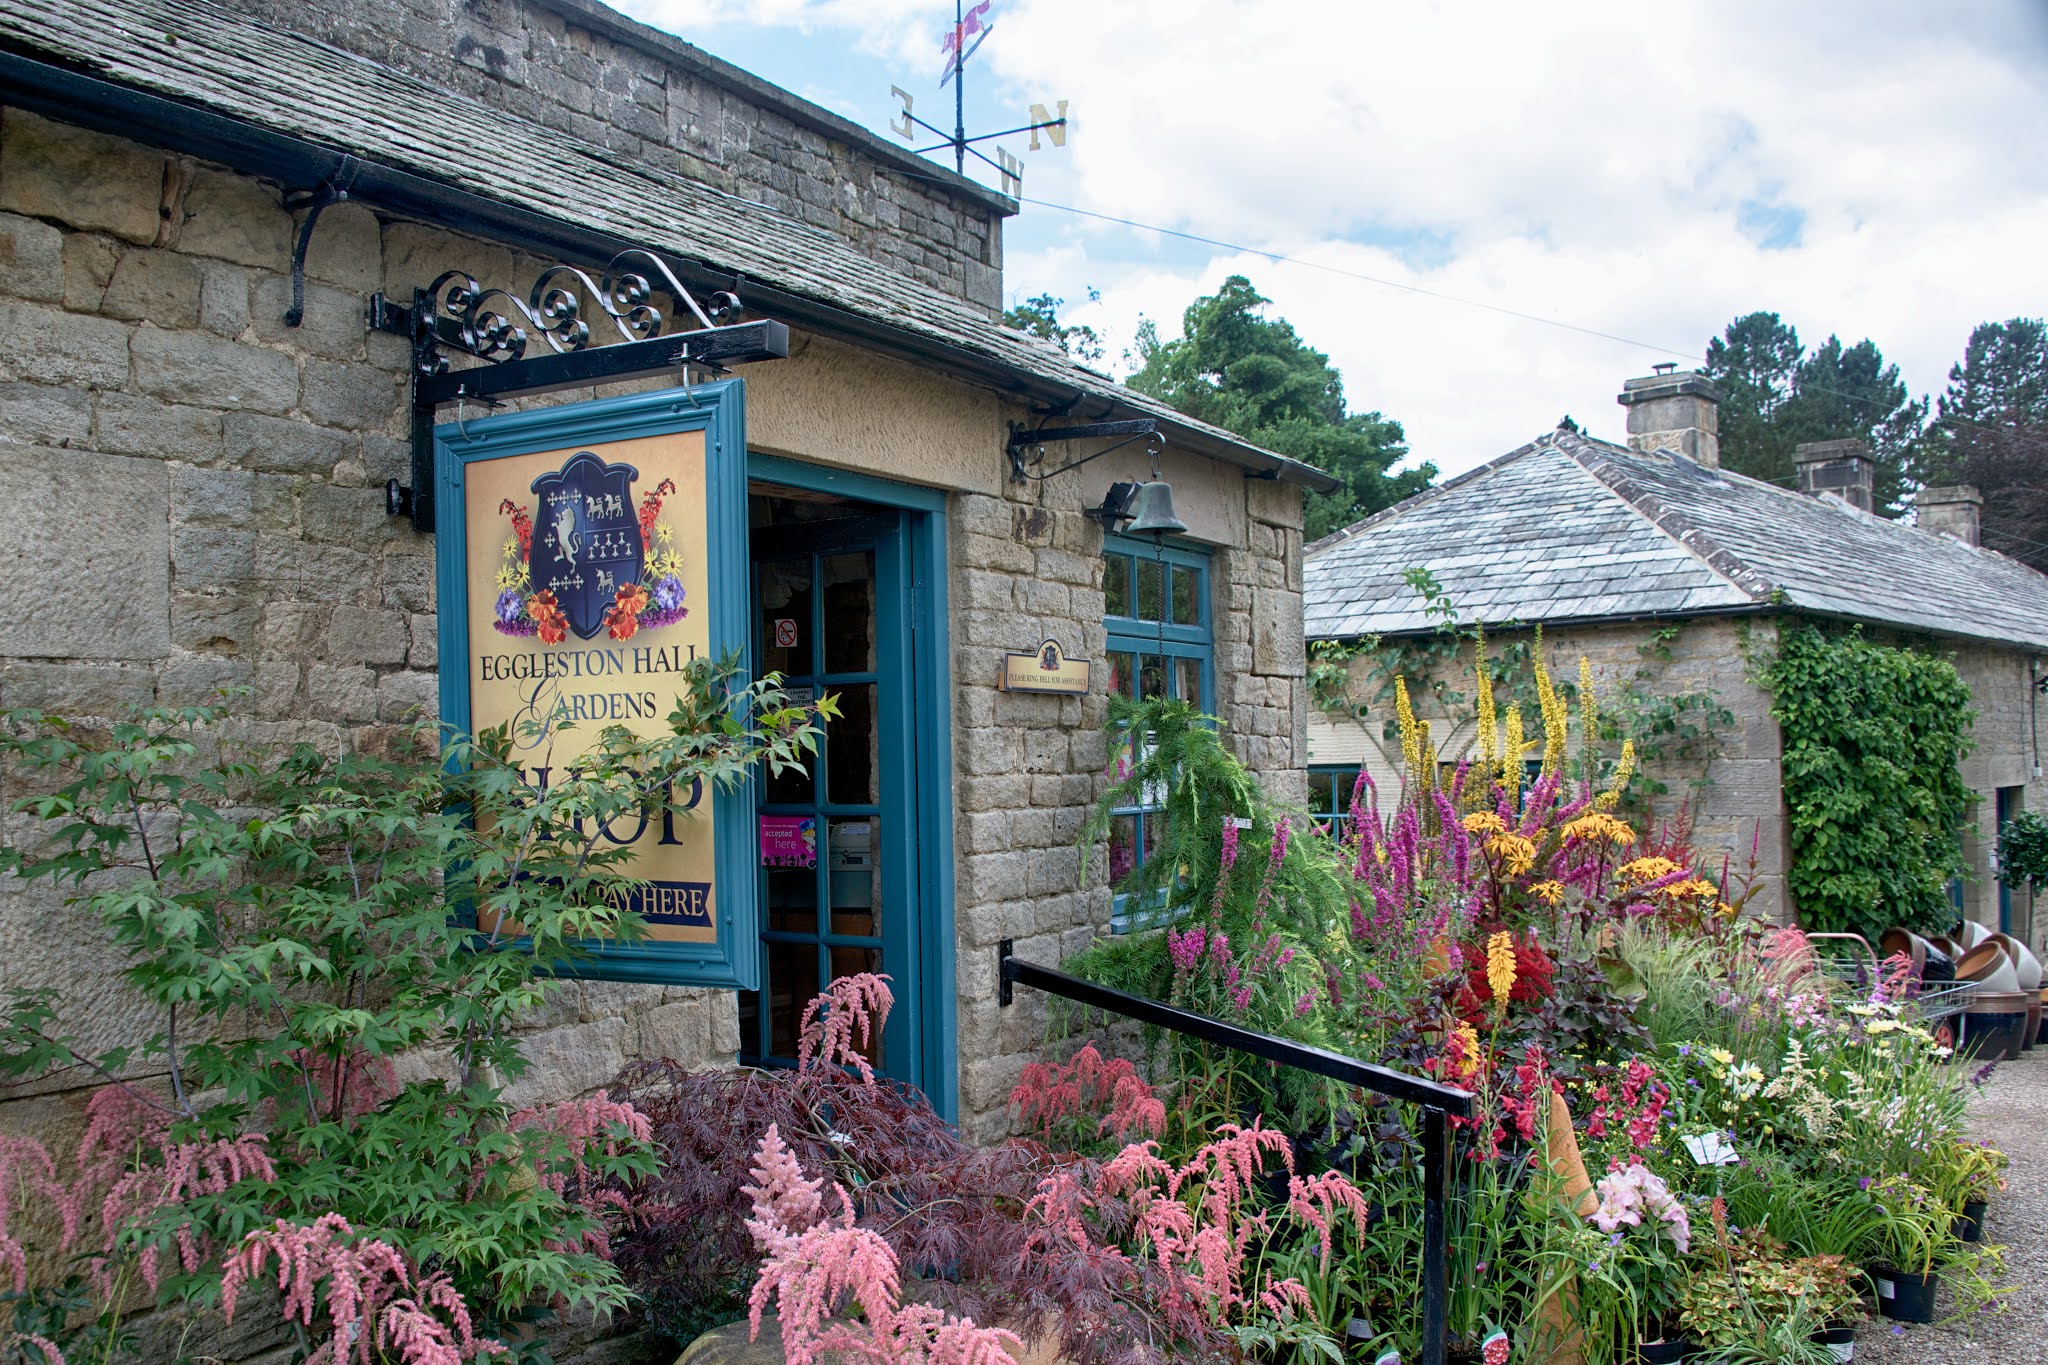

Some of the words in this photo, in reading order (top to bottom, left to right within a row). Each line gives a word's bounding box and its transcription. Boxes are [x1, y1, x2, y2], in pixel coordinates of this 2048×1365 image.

[1029, 100, 1068, 151] N
[997, 145, 1025, 200] W
[480, 648, 625, 681] EGGLESTON
[1008, 674, 1026, 682] PLEASE
[1026, 674, 1039, 683] RING
[1039, 676, 1051, 684] BELL
[1061, 677, 1086, 686] ASSISTANCE
[511, 668, 656, 749] GARDENS
[764, 830, 793, 838] accepted
[775, 838, 797, 849] here
[641, 887, 705, 916] HERE
